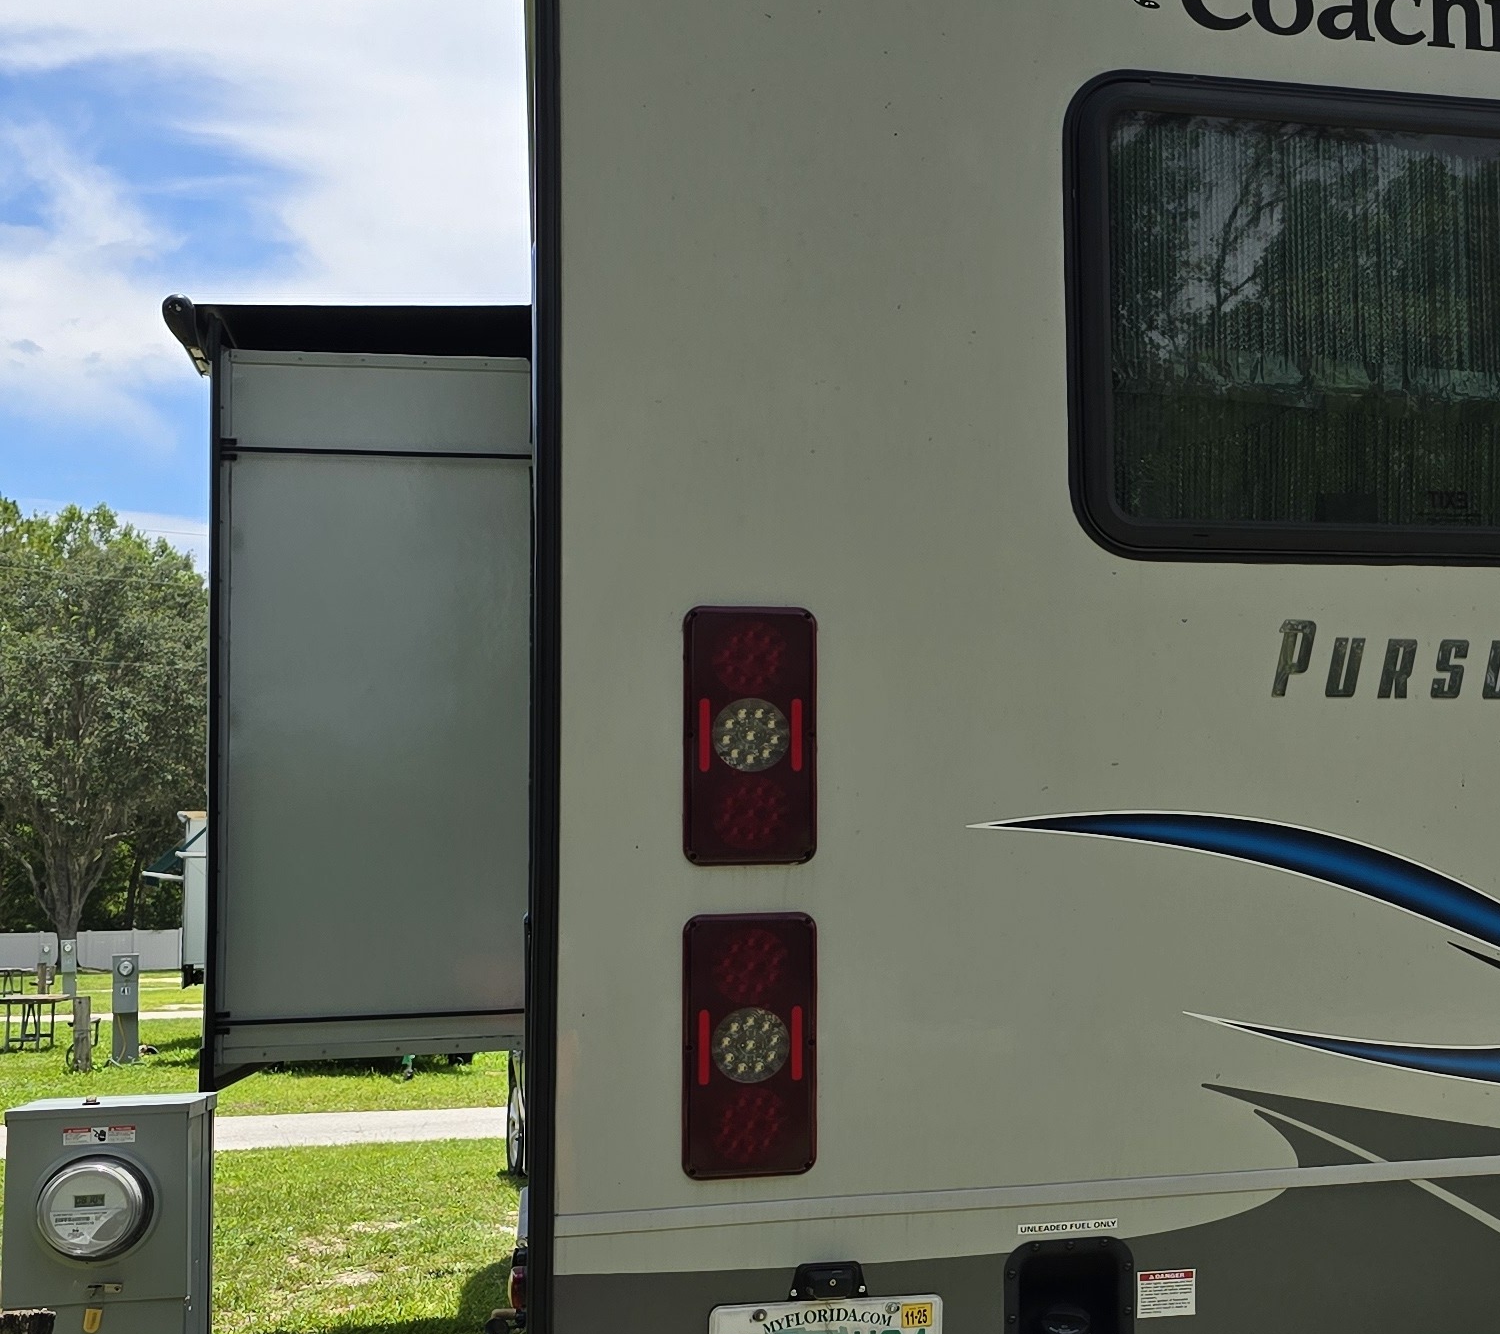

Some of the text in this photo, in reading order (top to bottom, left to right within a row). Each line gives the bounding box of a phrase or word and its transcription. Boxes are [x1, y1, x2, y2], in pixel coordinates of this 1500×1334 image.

[1020, 1220, 1117, 1233] UNLEADED FUEL ONLY
[762, 1307, 893, 1334] MYFLORIDA.COM
[905, 1309, 928, 1325] 11-25
